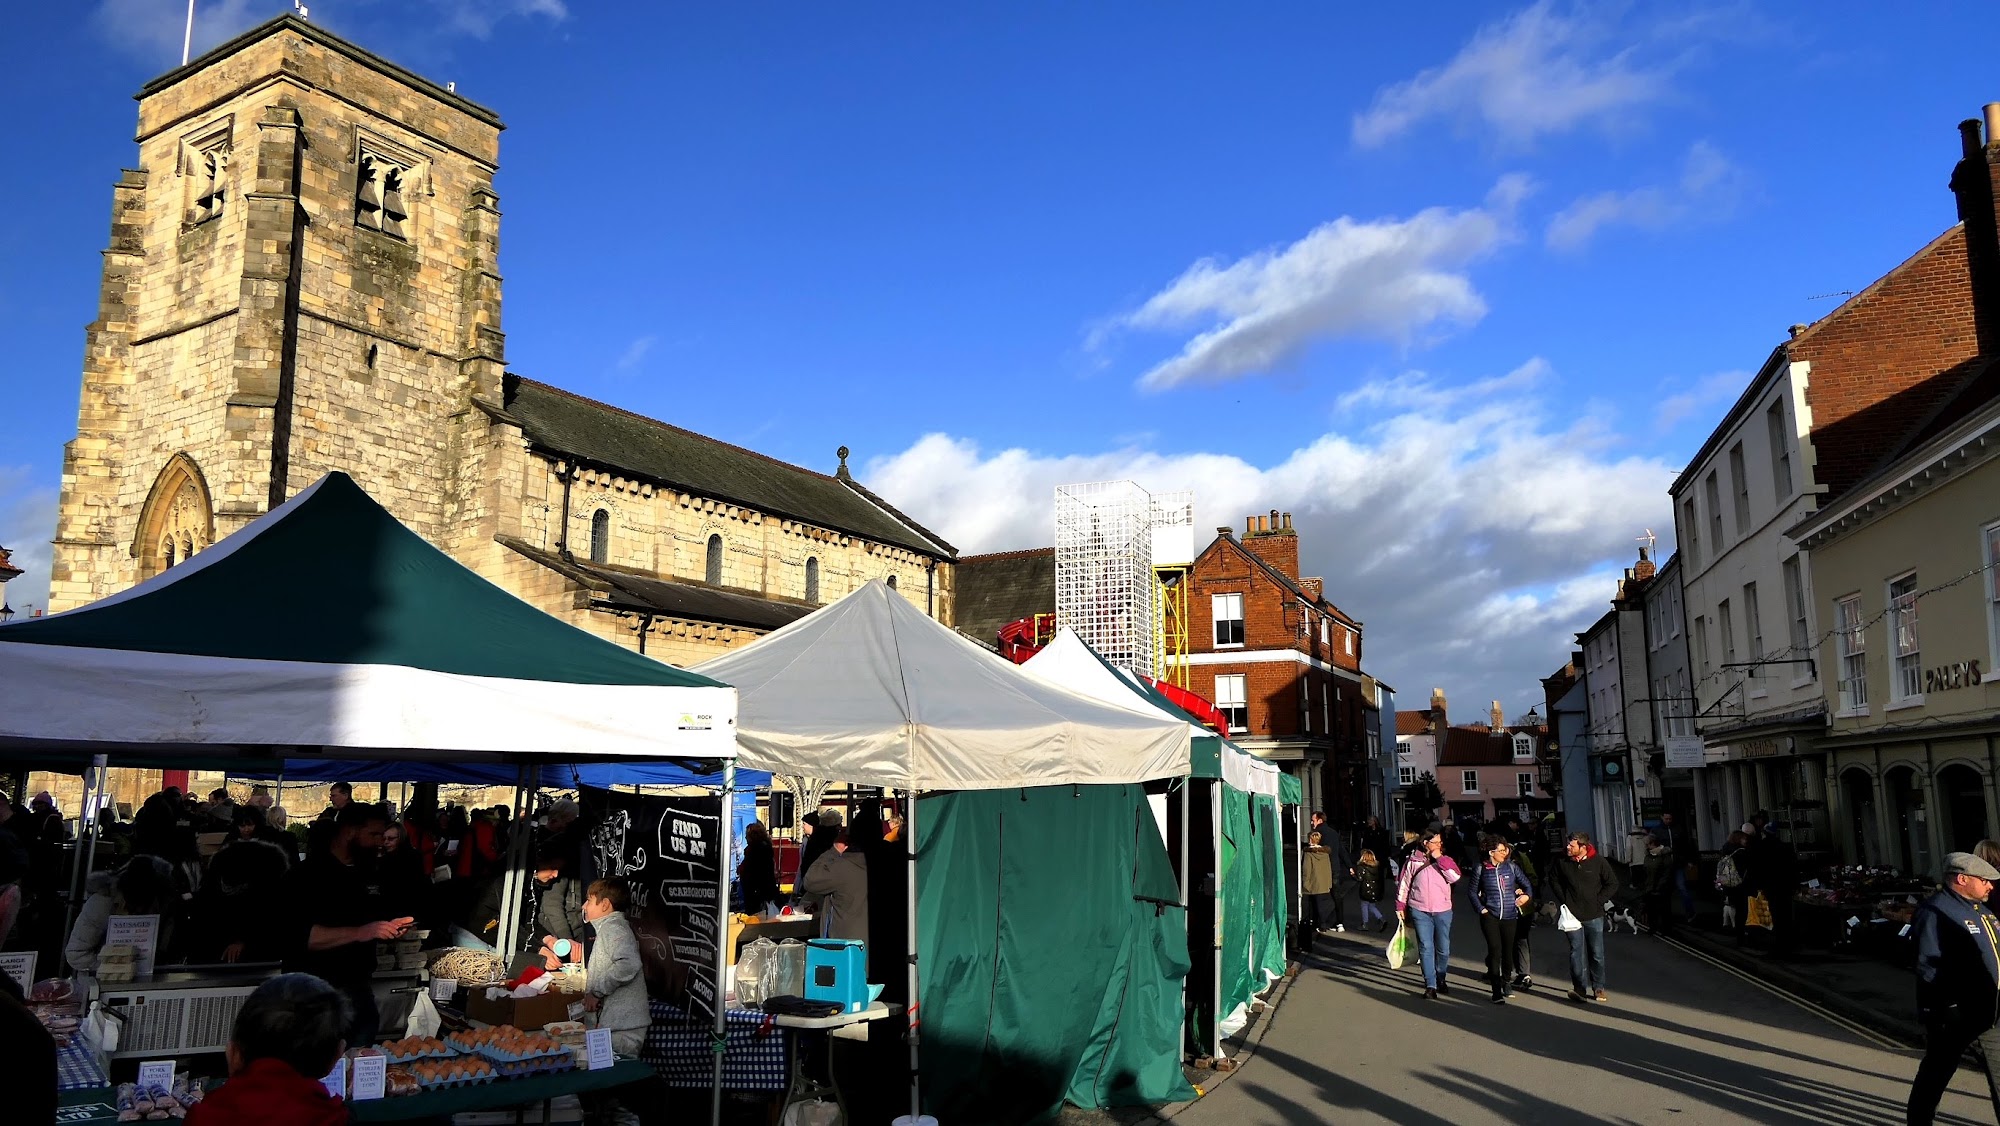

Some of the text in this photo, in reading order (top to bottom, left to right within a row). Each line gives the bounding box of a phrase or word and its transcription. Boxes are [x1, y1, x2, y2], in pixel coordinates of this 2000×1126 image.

[1926, 659, 1982, 693] PALEYS
[672, 818, 702, 838] FIND
[670, 836, 707, 857] US AT
[668, 886, 716, 899] SCARBOROUGH
[688, 911, 715, 936] MALTON
[674, 944, 700, 957] HUMBER
[693, 978, 714, 1002] ACOMB
[56, 1111, 92, 1121] LTD
